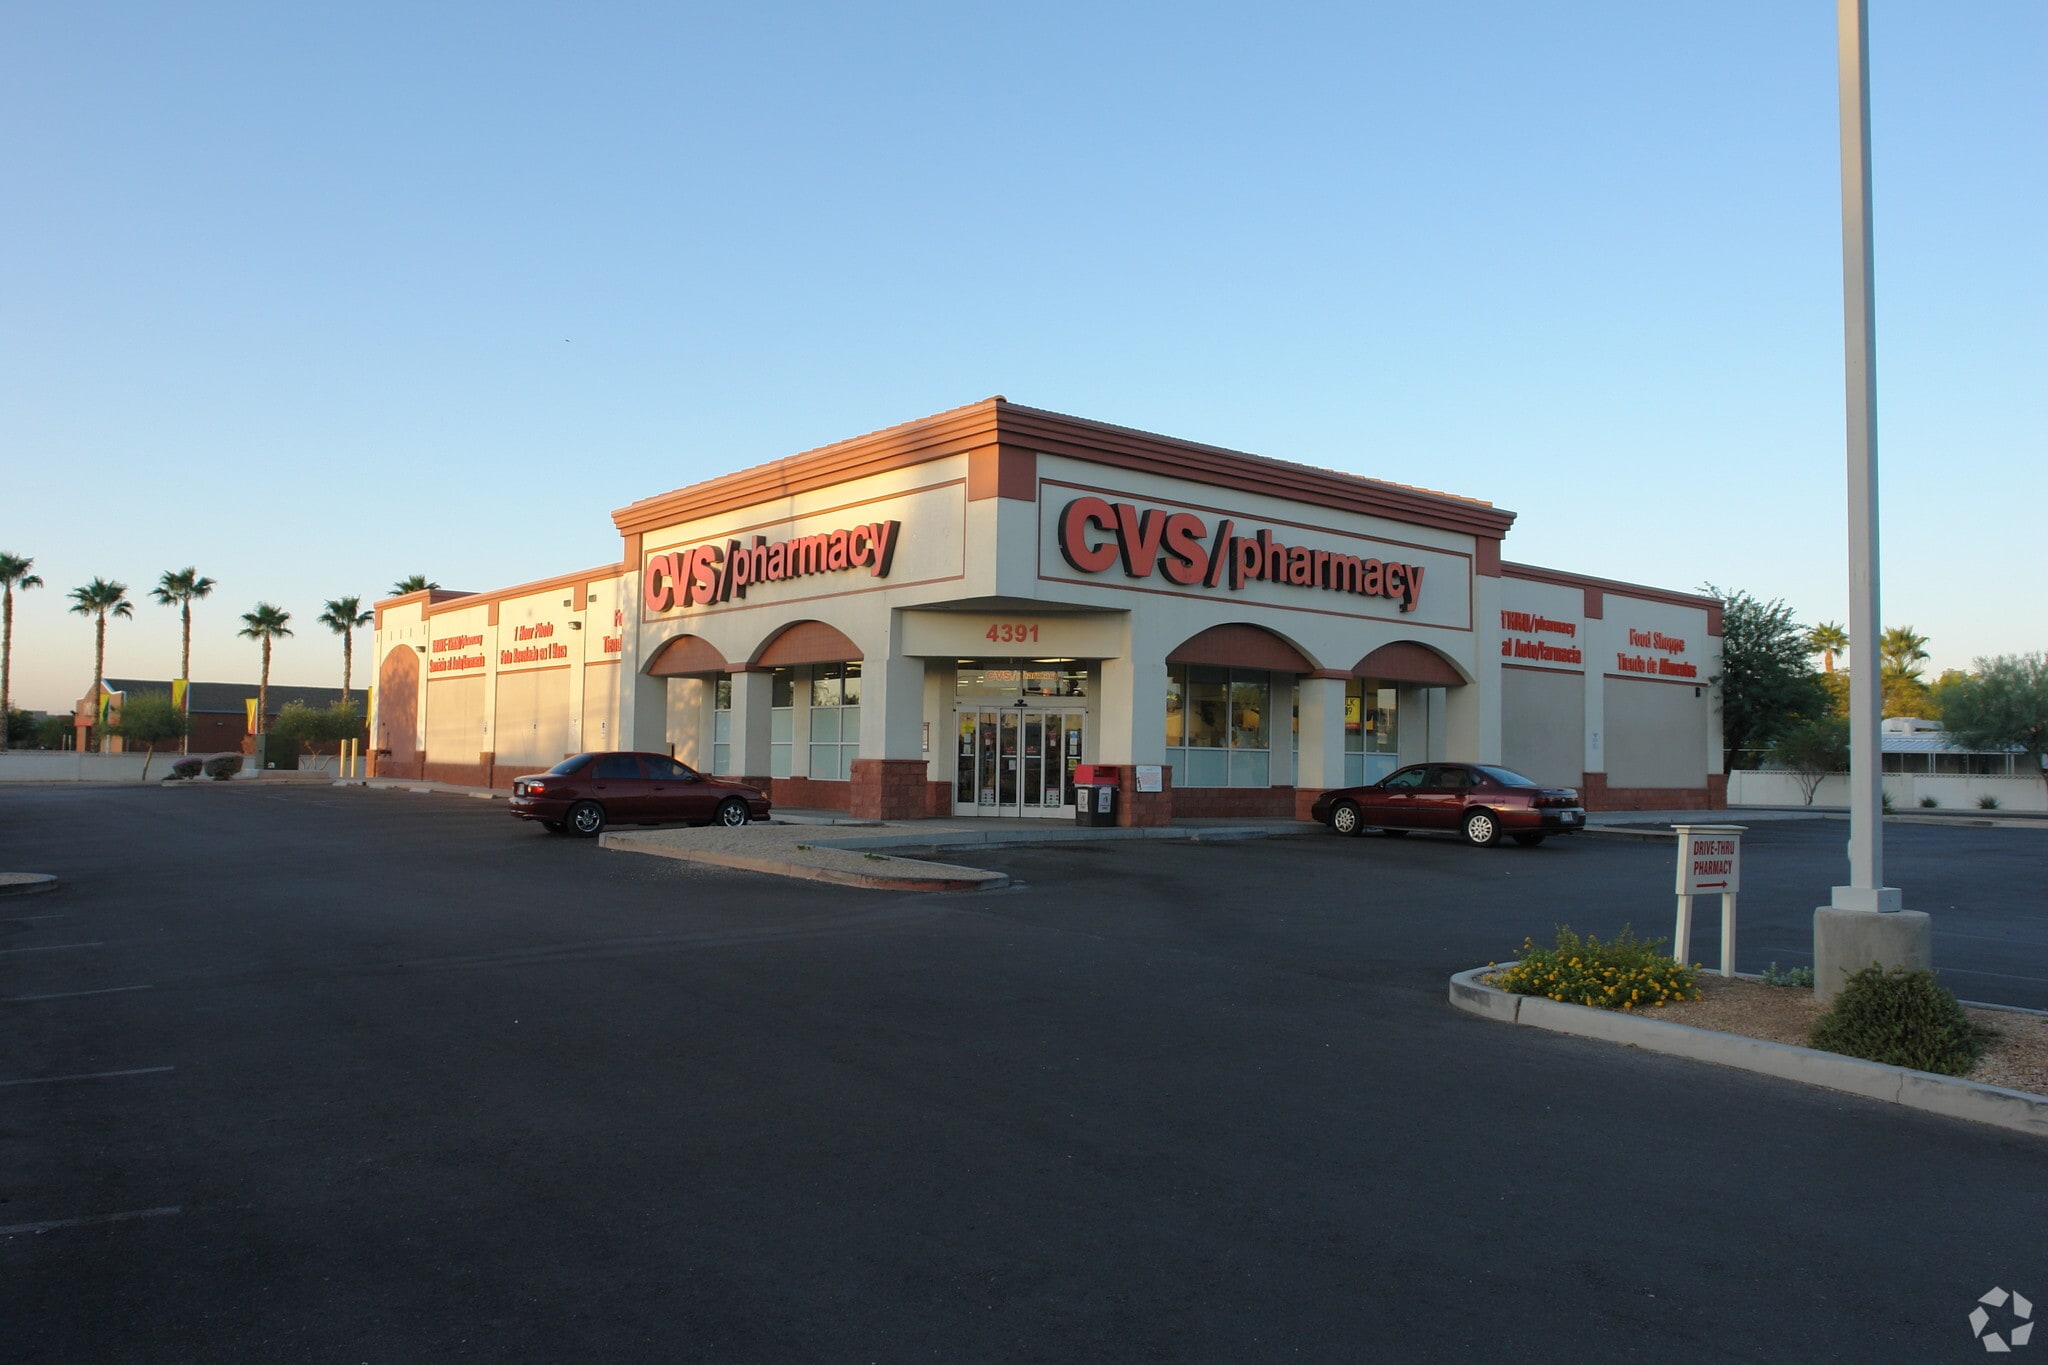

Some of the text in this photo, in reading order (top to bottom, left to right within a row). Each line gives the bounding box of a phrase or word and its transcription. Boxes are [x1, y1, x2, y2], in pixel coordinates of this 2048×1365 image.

[1058, 496, 1425, 613] CVS/pharmacy
[644, 519, 902, 613] CVS/pharmacy
[986, 623, 1040, 643] 4391
[1629, 627, 1685, 655] Food Shoppe
[1616, 652, 1646, 673] Tienda
[1693, 840, 1735, 856] DRIVE-THRU
[1693, 860, 1733, 876] PHARMACY
